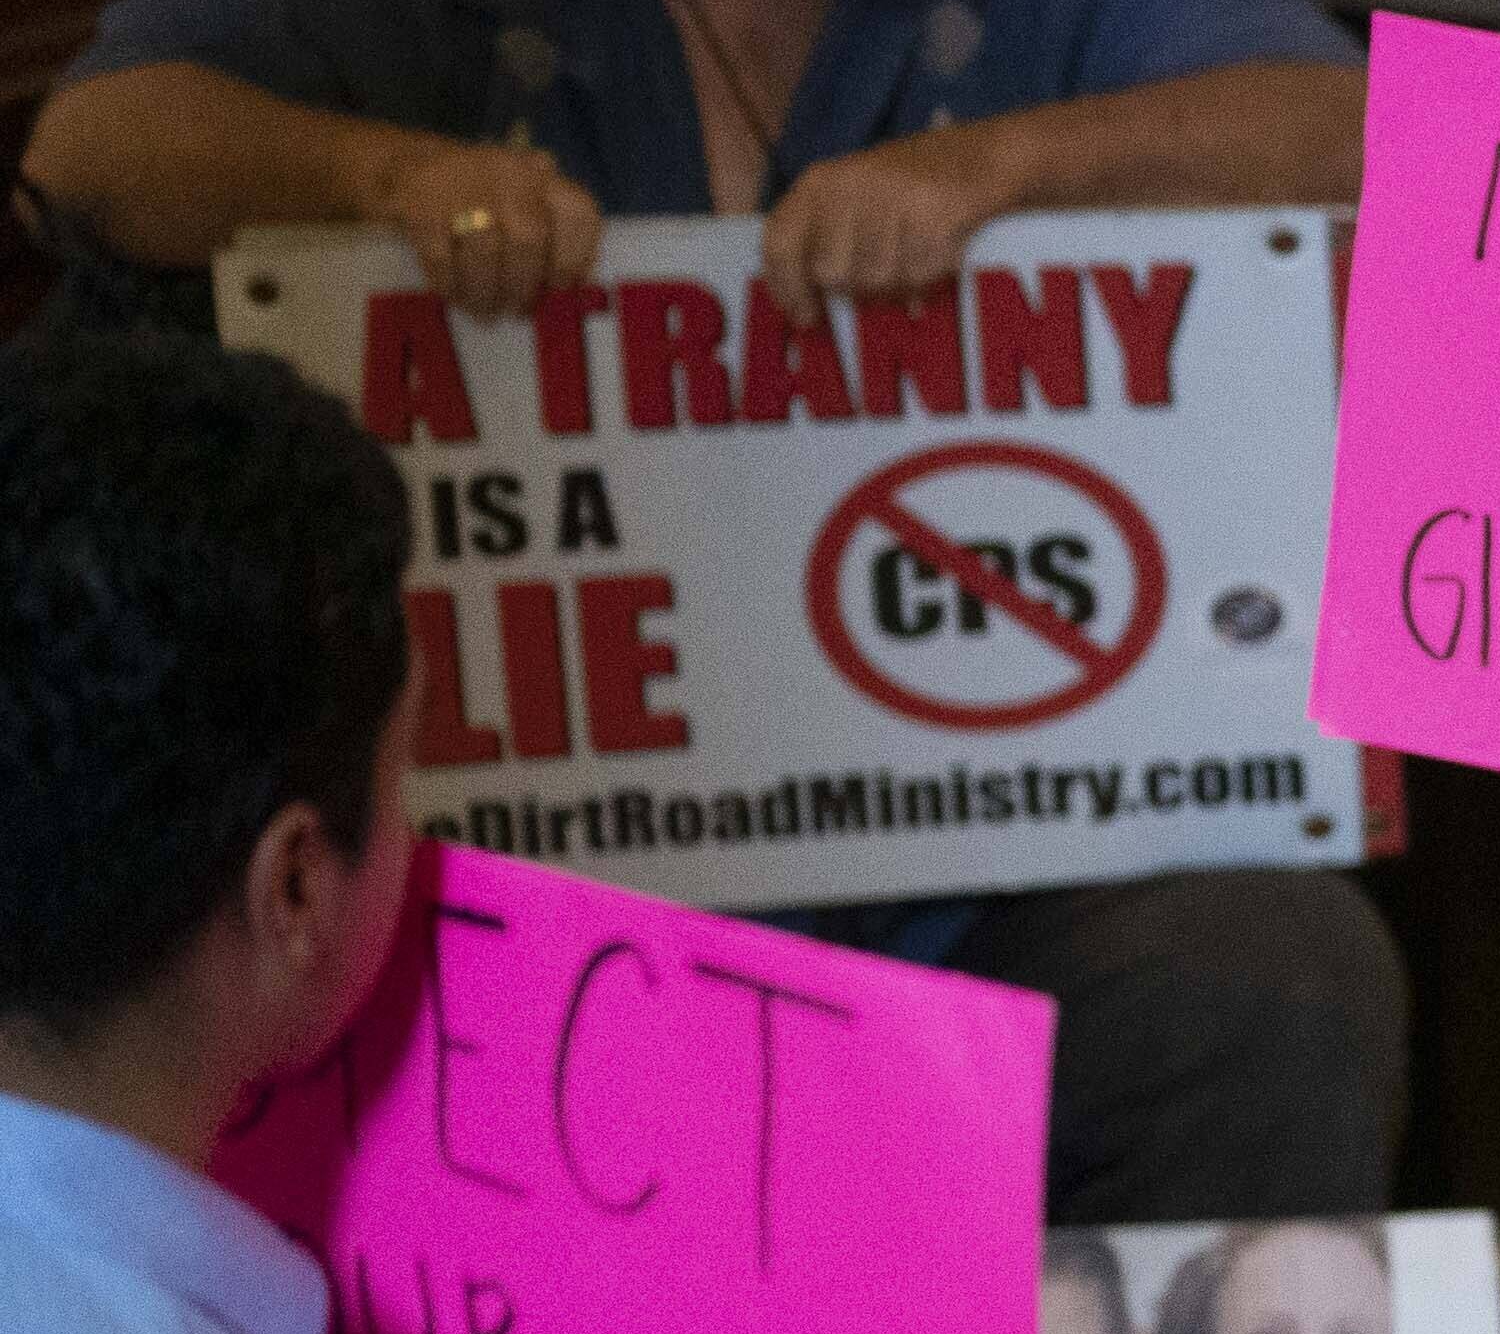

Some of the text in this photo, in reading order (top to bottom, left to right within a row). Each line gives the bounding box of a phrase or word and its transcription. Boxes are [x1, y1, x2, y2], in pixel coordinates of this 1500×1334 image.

[362, 264, 1194, 445] A TRANNY
[431, 464, 622, 560] IS A
[868, 530, 1097, 641] CPS
[403, 574, 690, 767] LIE
